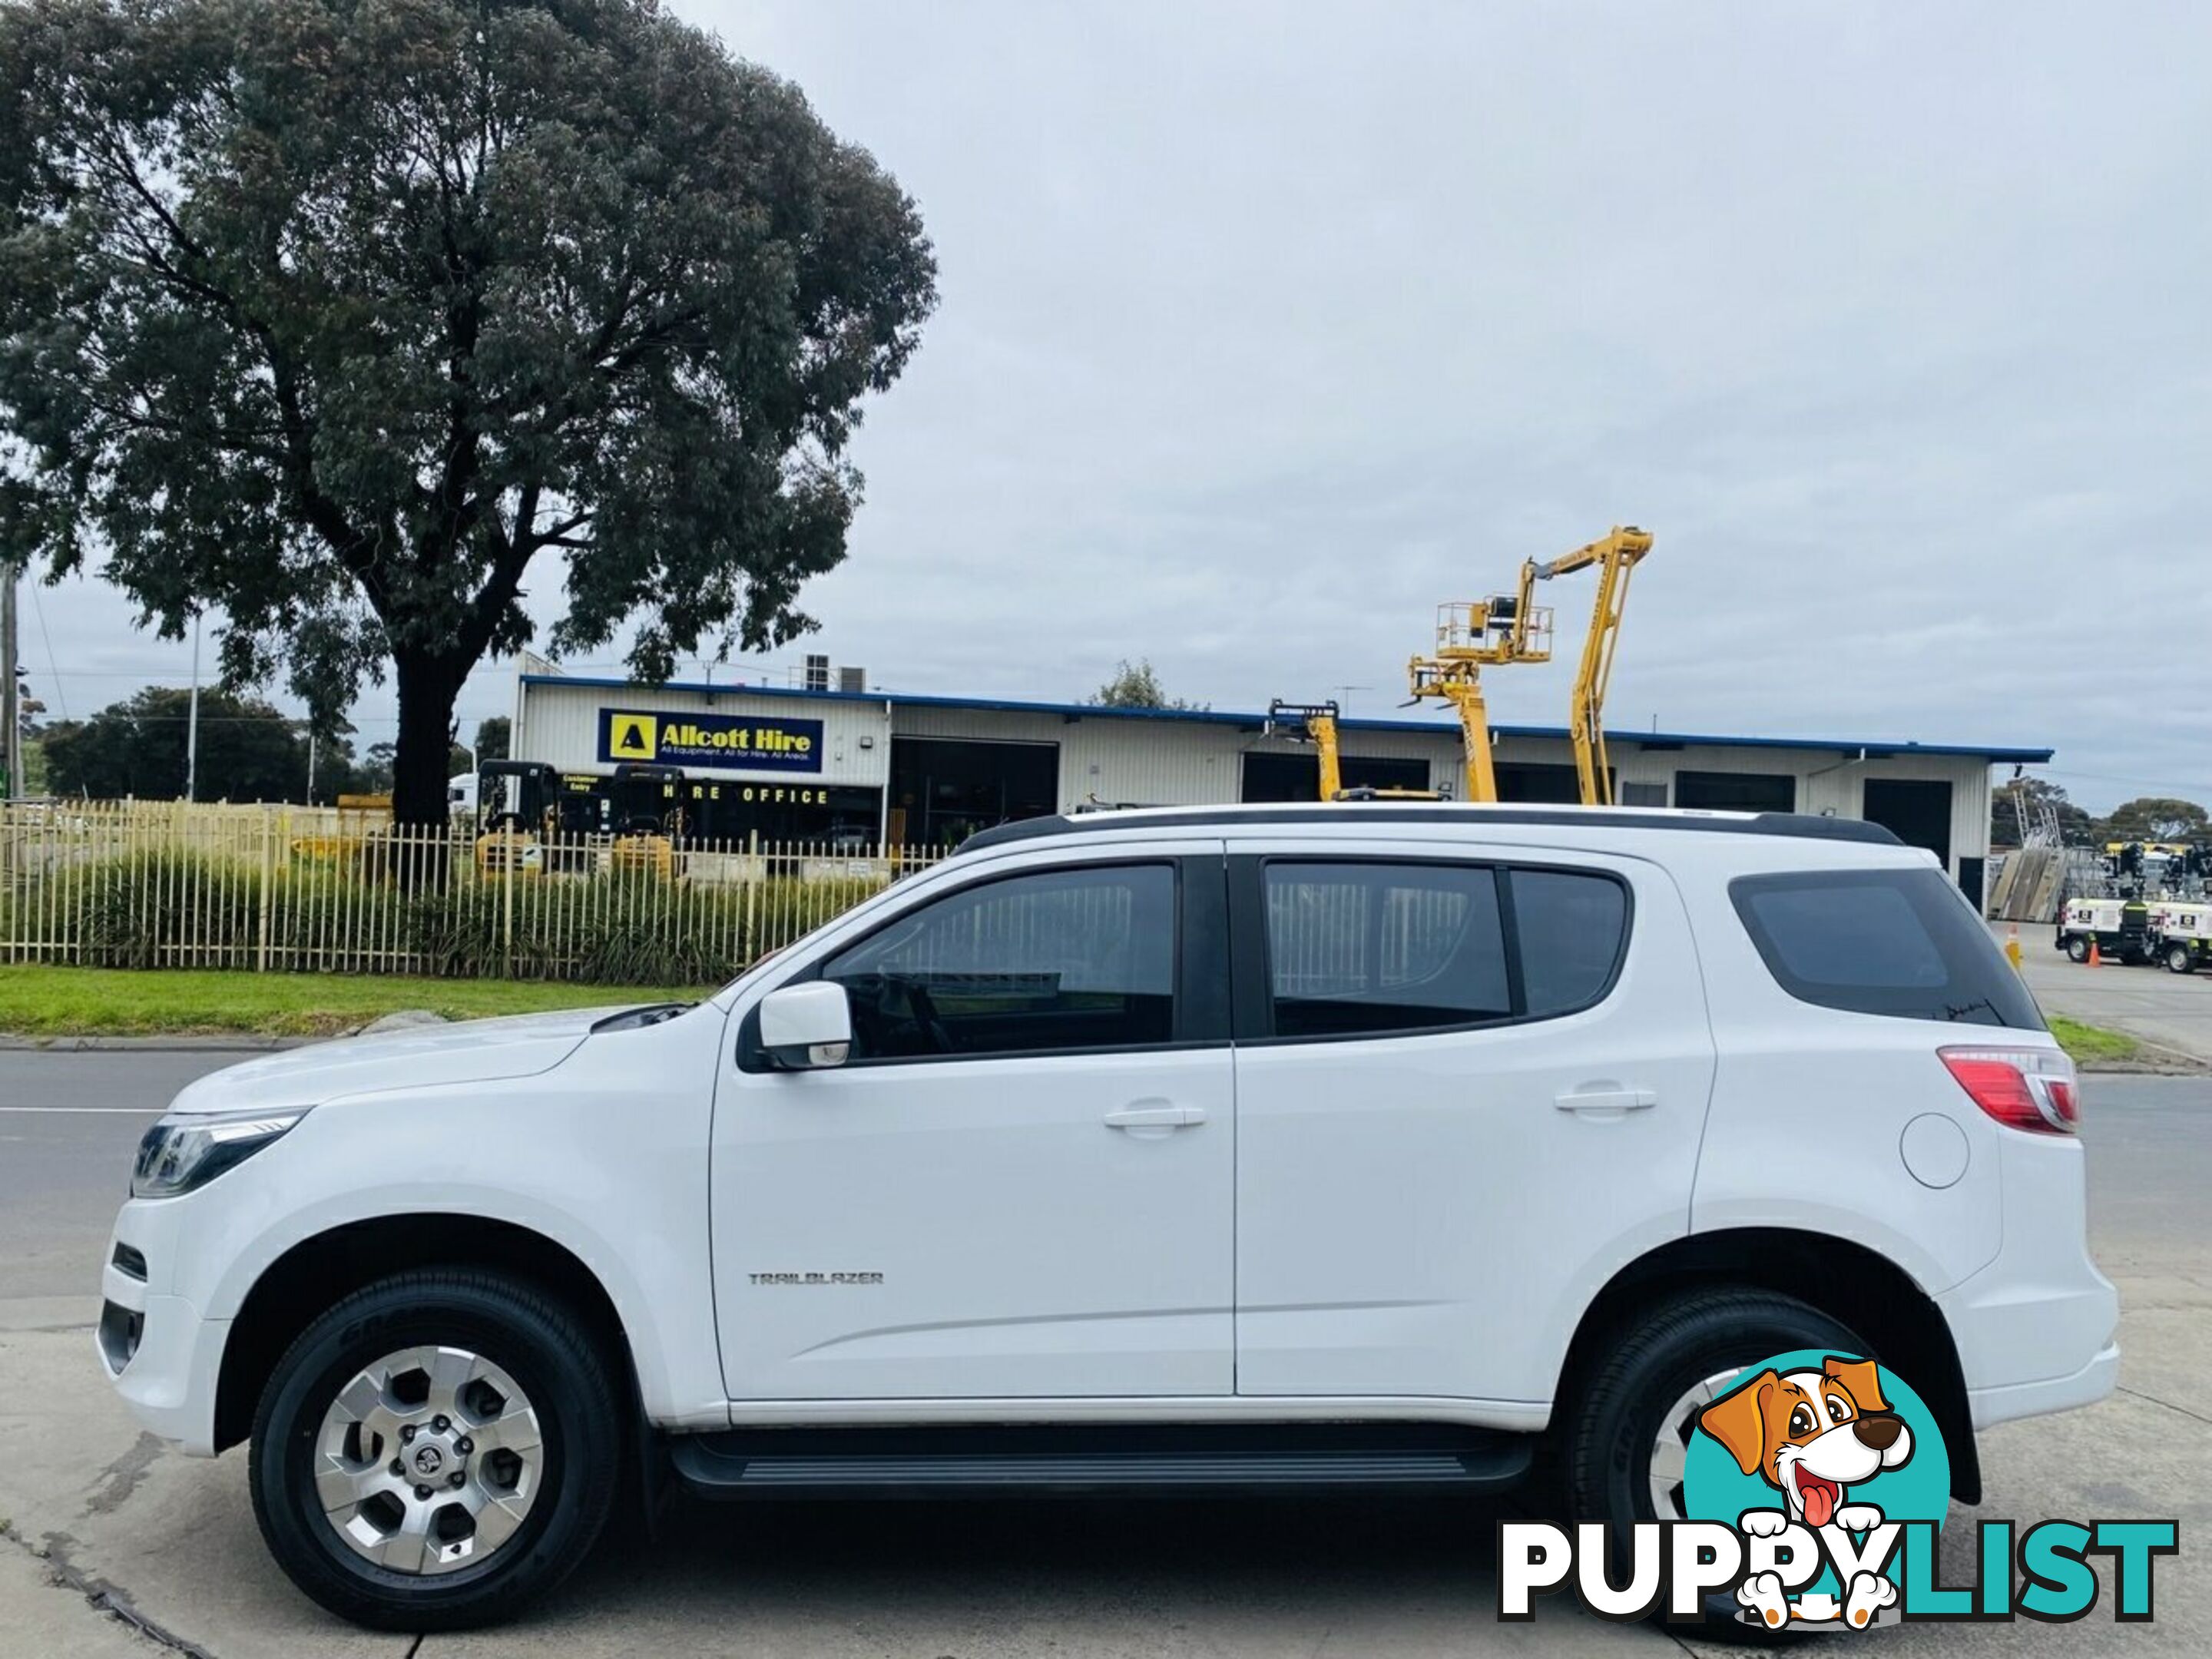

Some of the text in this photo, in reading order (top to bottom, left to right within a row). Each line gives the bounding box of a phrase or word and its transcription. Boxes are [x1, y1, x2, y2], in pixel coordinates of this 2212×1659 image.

[661, 724, 811, 751] Allcott Hire
[663, 784, 828, 804] HRE OFFICE
[749, 1273, 883, 1285] TRAILBLAZER
